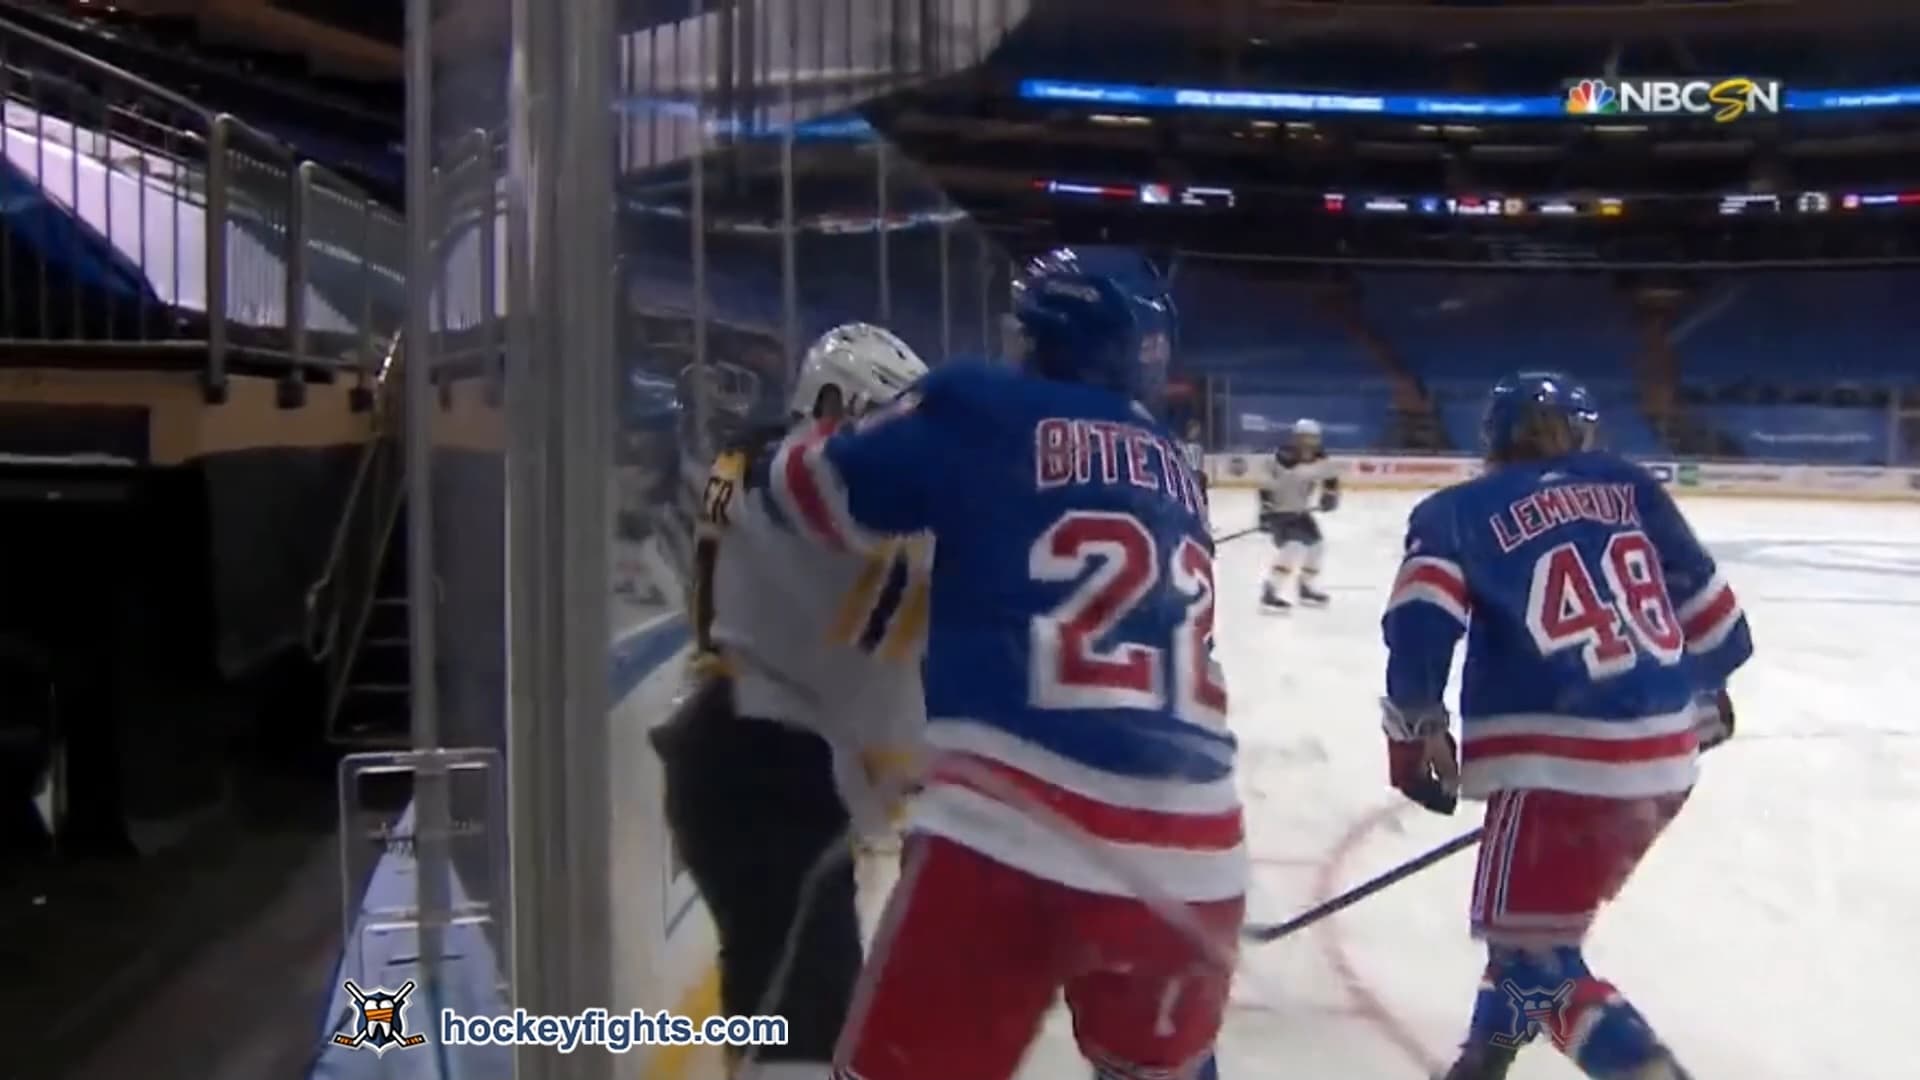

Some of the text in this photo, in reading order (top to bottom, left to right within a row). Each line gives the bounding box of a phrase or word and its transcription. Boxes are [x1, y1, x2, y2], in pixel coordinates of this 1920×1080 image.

[1490, 484, 1641, 553] LEMIEUX
[1028, 510, 1228, 736] 22
[1526, 531, 1684, 681] 48
